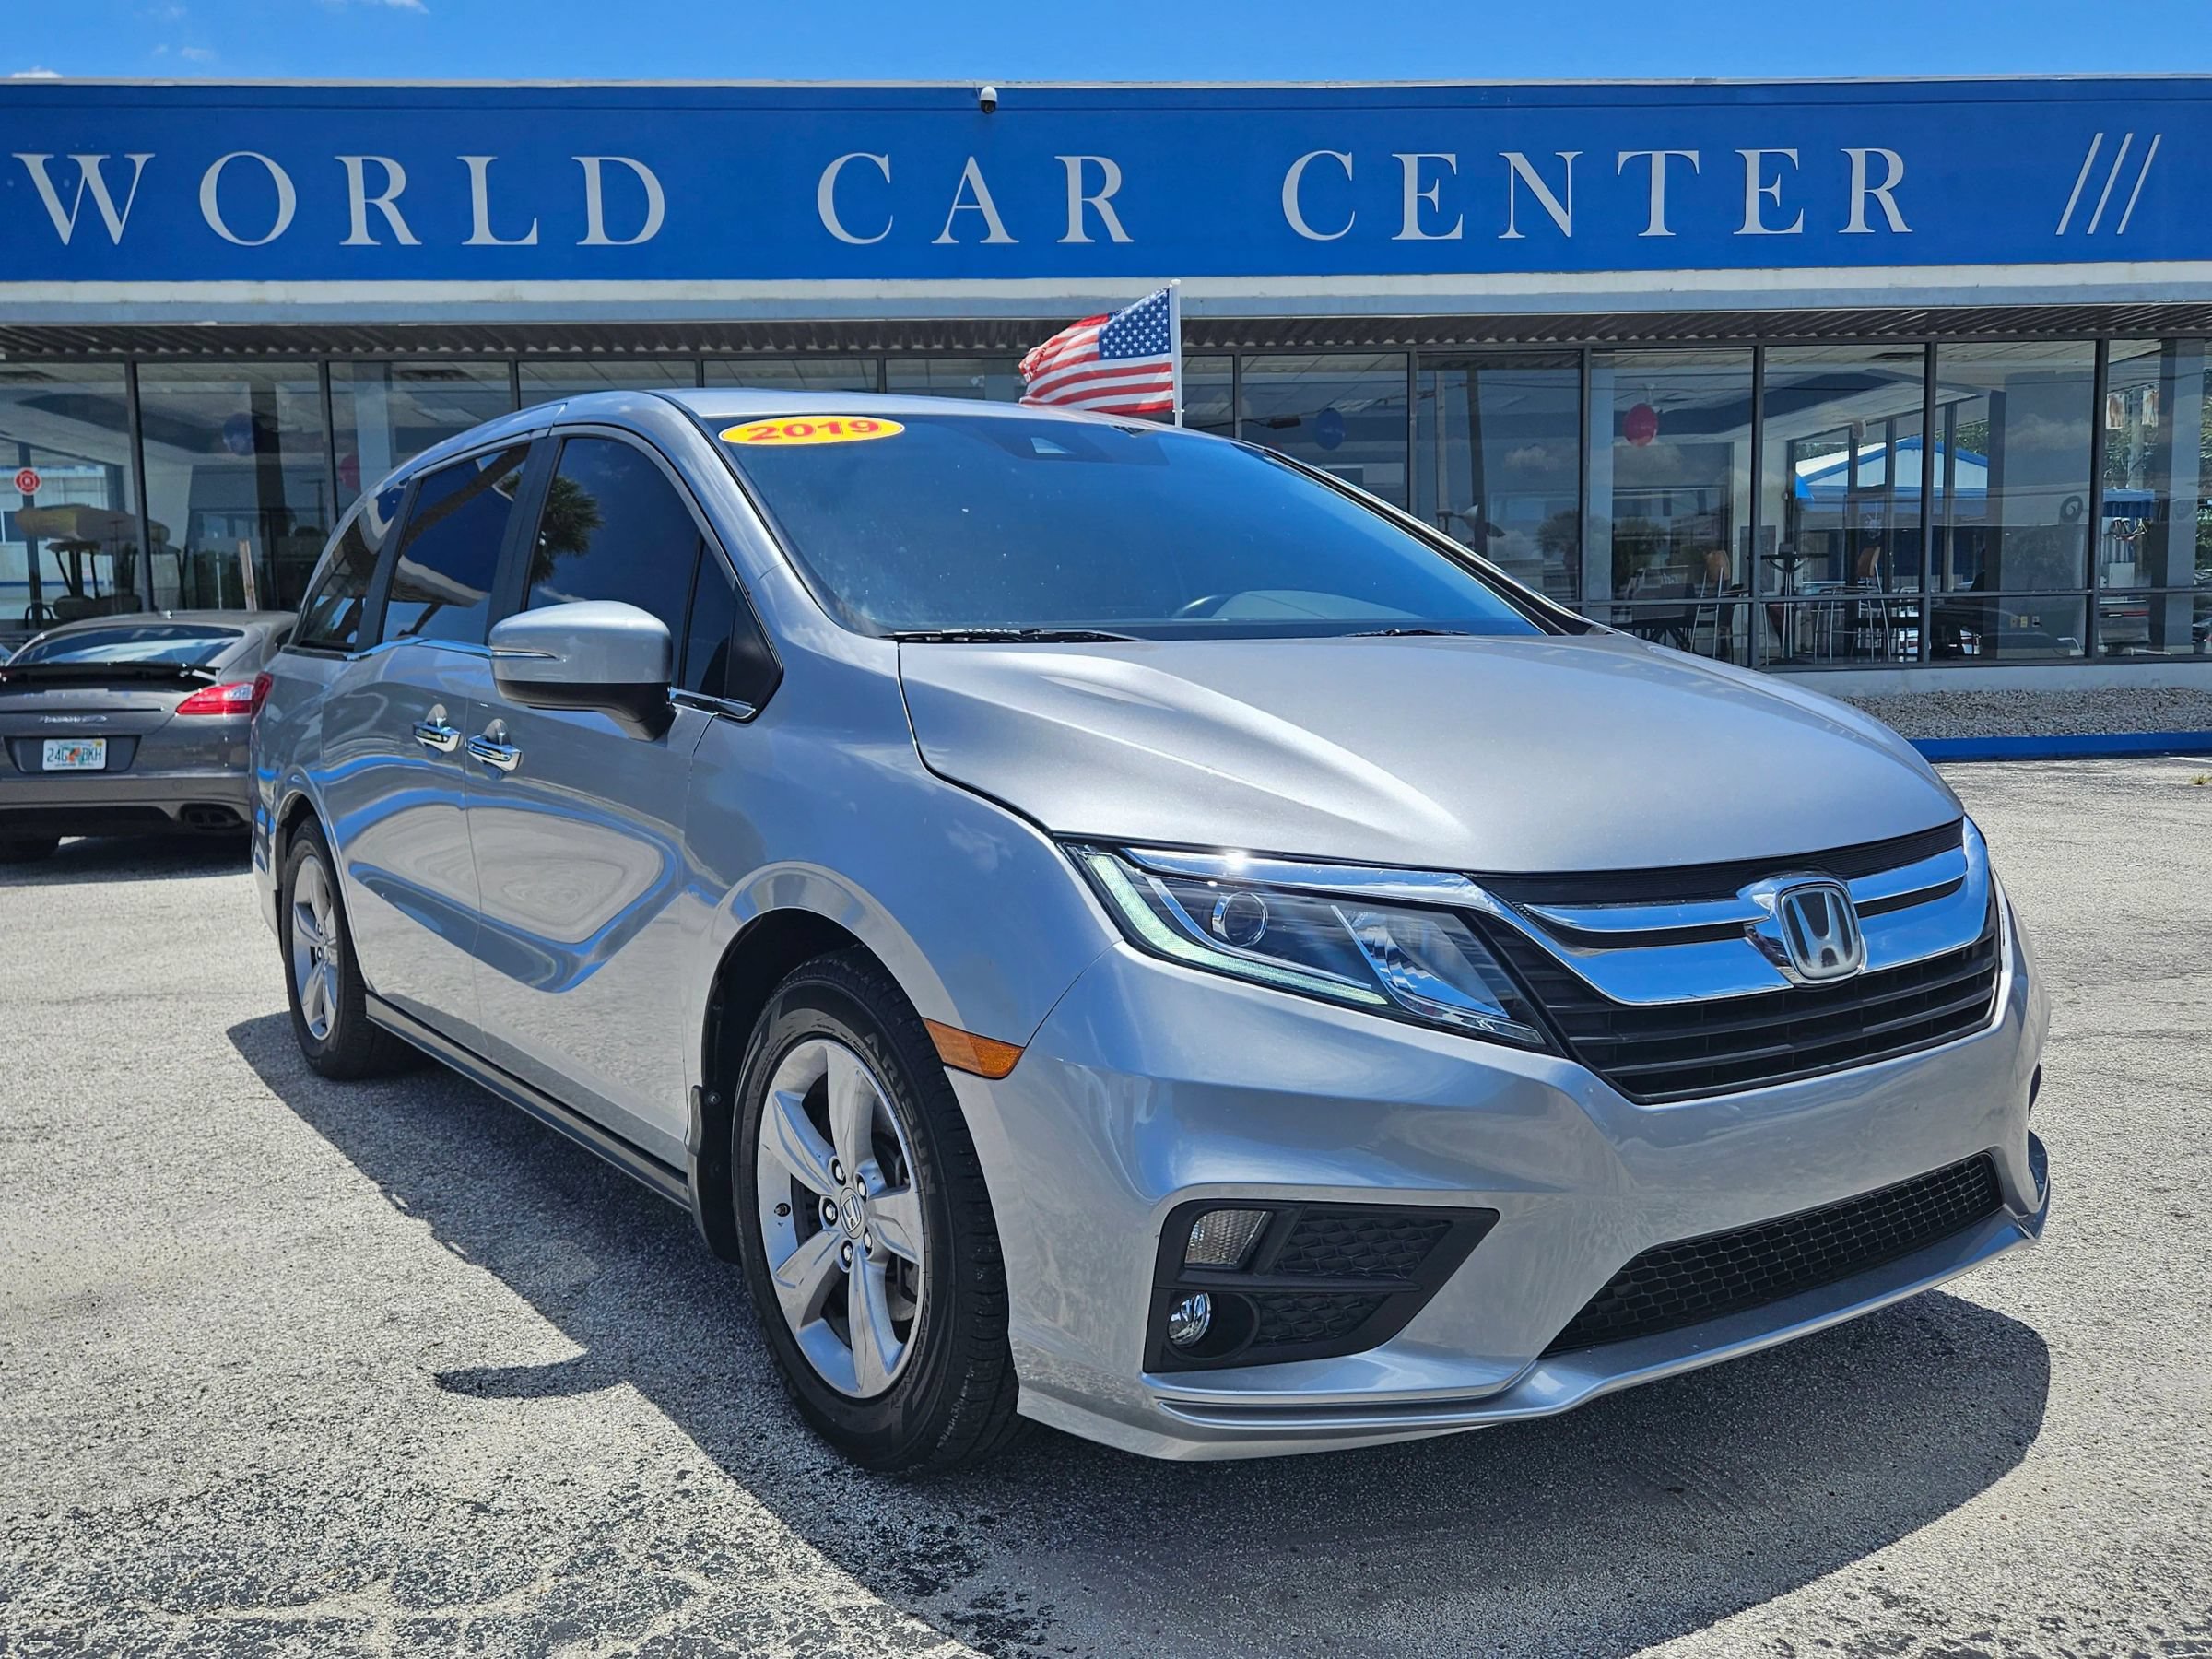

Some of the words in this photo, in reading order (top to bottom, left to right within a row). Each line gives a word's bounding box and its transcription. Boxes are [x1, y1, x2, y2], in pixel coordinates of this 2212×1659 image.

[12, 151, 665, 246] WORLD
[817, 151, 1133, 246] CAR
[1281, 147, 1913, 242] CENTER
[747, 420, 880, 441] 2019
[865, 1032, 936, 1194] ARISUN
